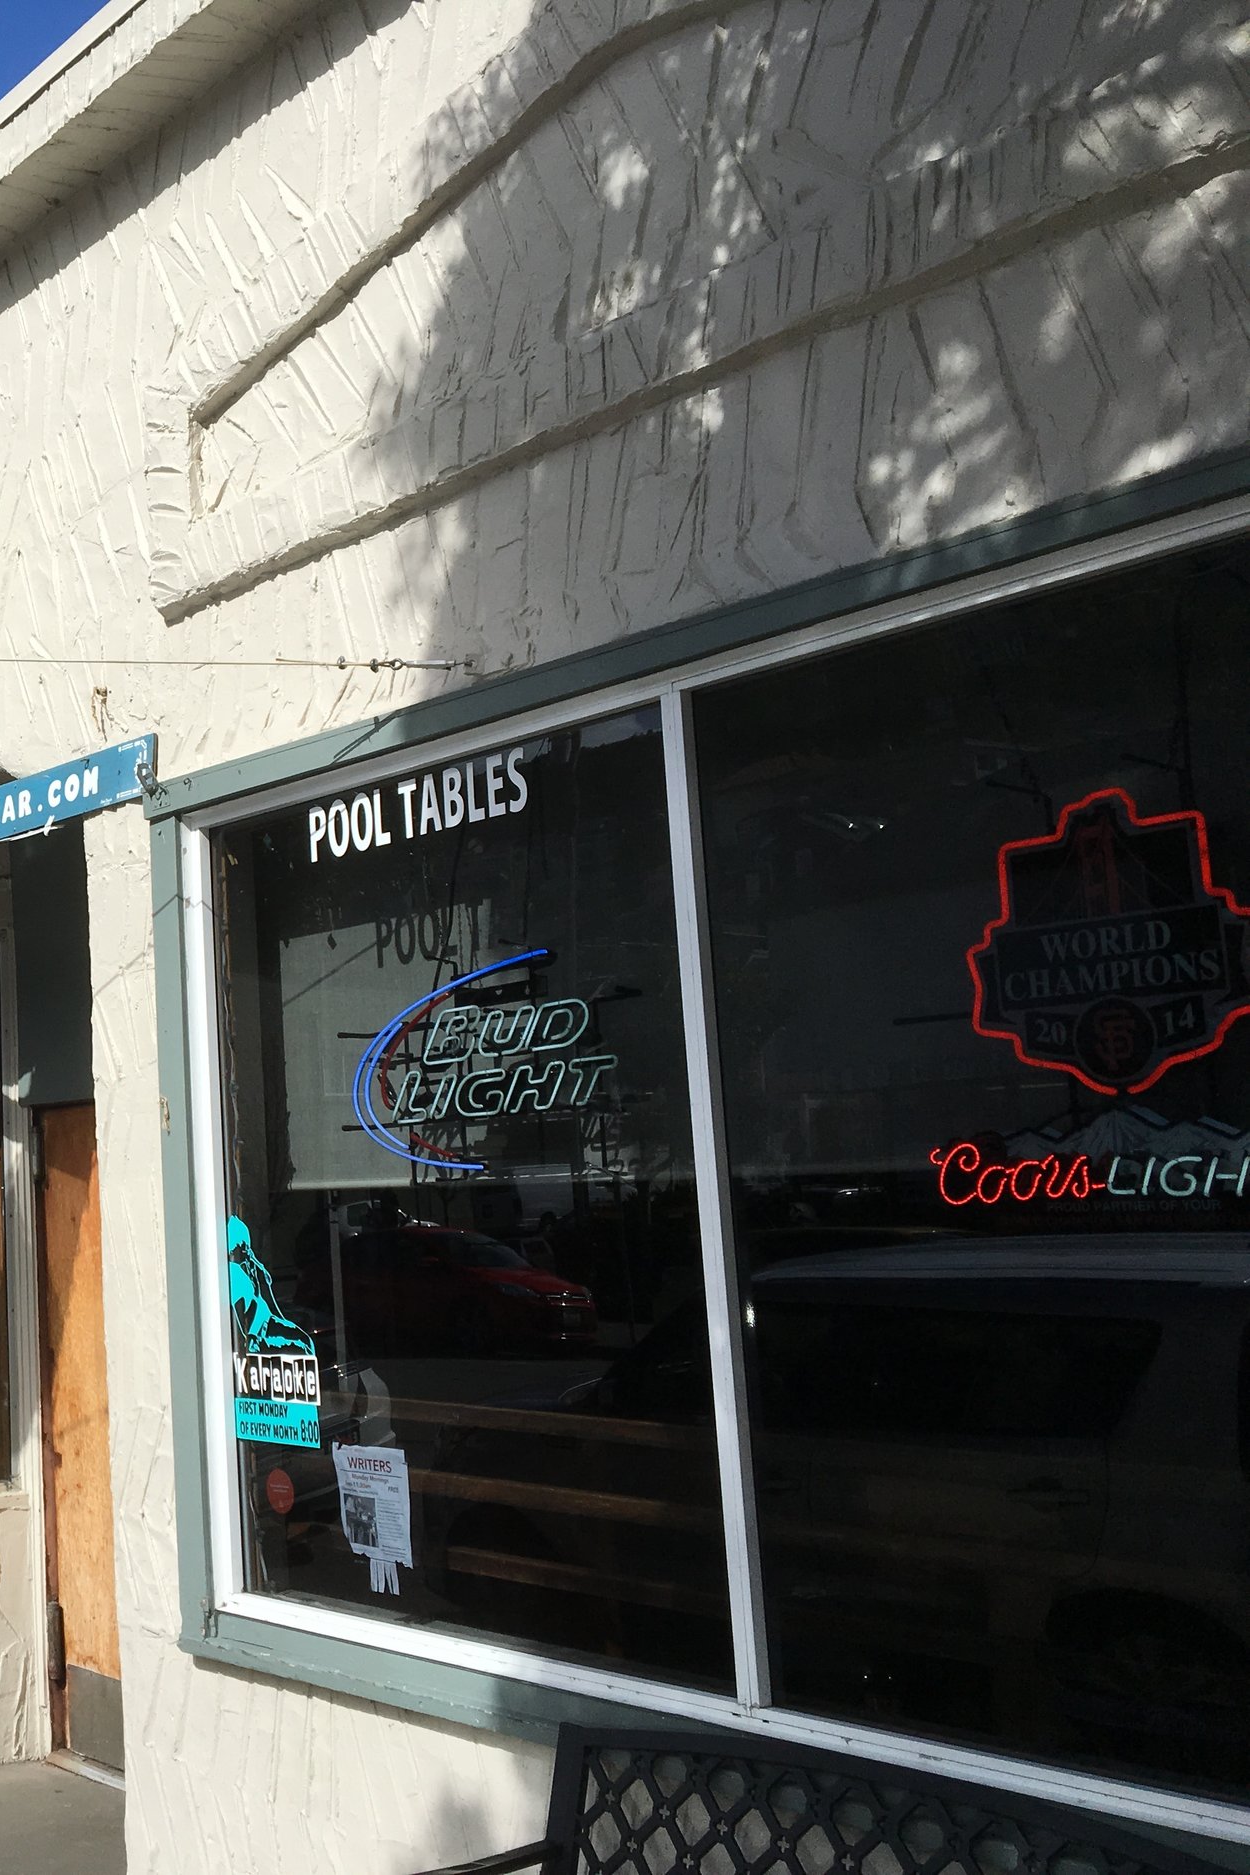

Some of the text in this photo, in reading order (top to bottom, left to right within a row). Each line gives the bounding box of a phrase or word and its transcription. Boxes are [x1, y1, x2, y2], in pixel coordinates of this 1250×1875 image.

[308, 746, 528, 863] POOL TABLES
[1040, 920, 1171, 963] WORLD
[1004, 949, 1220, 1001] CHAMPIONS
[423, 998, 590, 1067] BUD
[1034, 1018, 1067, 1045] 20
[1163, 1001, 1196, 1037] 14
[392, 1055, 618, 1124] LIGHT
[930, 1143, 1097, 1205] Coors
[1094, 1200, 1154, 1213] PARTNER
[237, 1357, 316, 1395] Karaoke
[239, 1401, 288, 1418] FIRST MONDAY
[240, 1421, 249, 1435] OF
[250, 1421, 271, 1437] EVERY
[273, 1423, 299, 1440] MONTH
[347, 1456, 392, 1474] WRITERS
